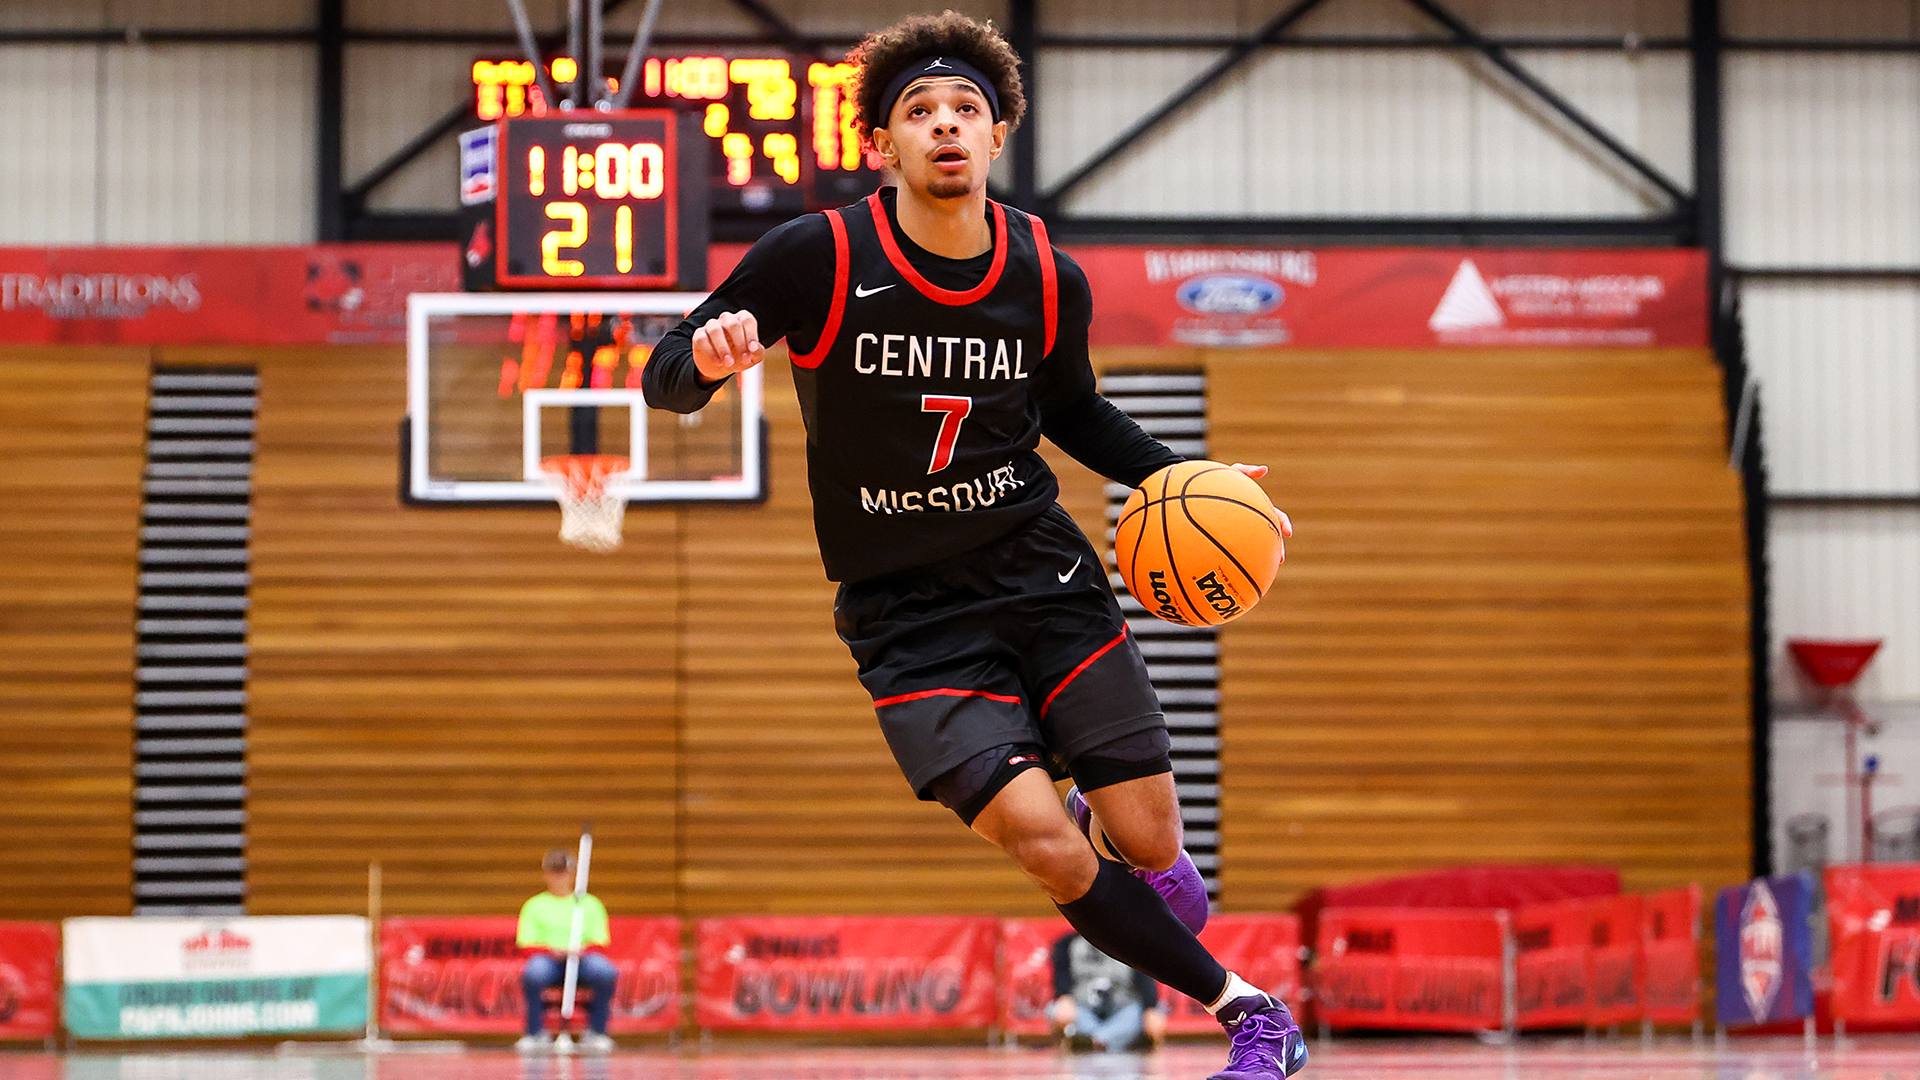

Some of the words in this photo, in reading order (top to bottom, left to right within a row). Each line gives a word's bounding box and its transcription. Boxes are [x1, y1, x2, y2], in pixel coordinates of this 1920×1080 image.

[528, 142, 664, 199] 11:00
[541, 201, 633, 277] 21
[0, 273, 200, 312] TRADITIONS
[855, 332, 1028, 380] CENTRAL
[921, 394, 973, 475] 7
[1194, 570, 1244, 621] NCAA
[732, 955, 965, 1017] BOWLING
